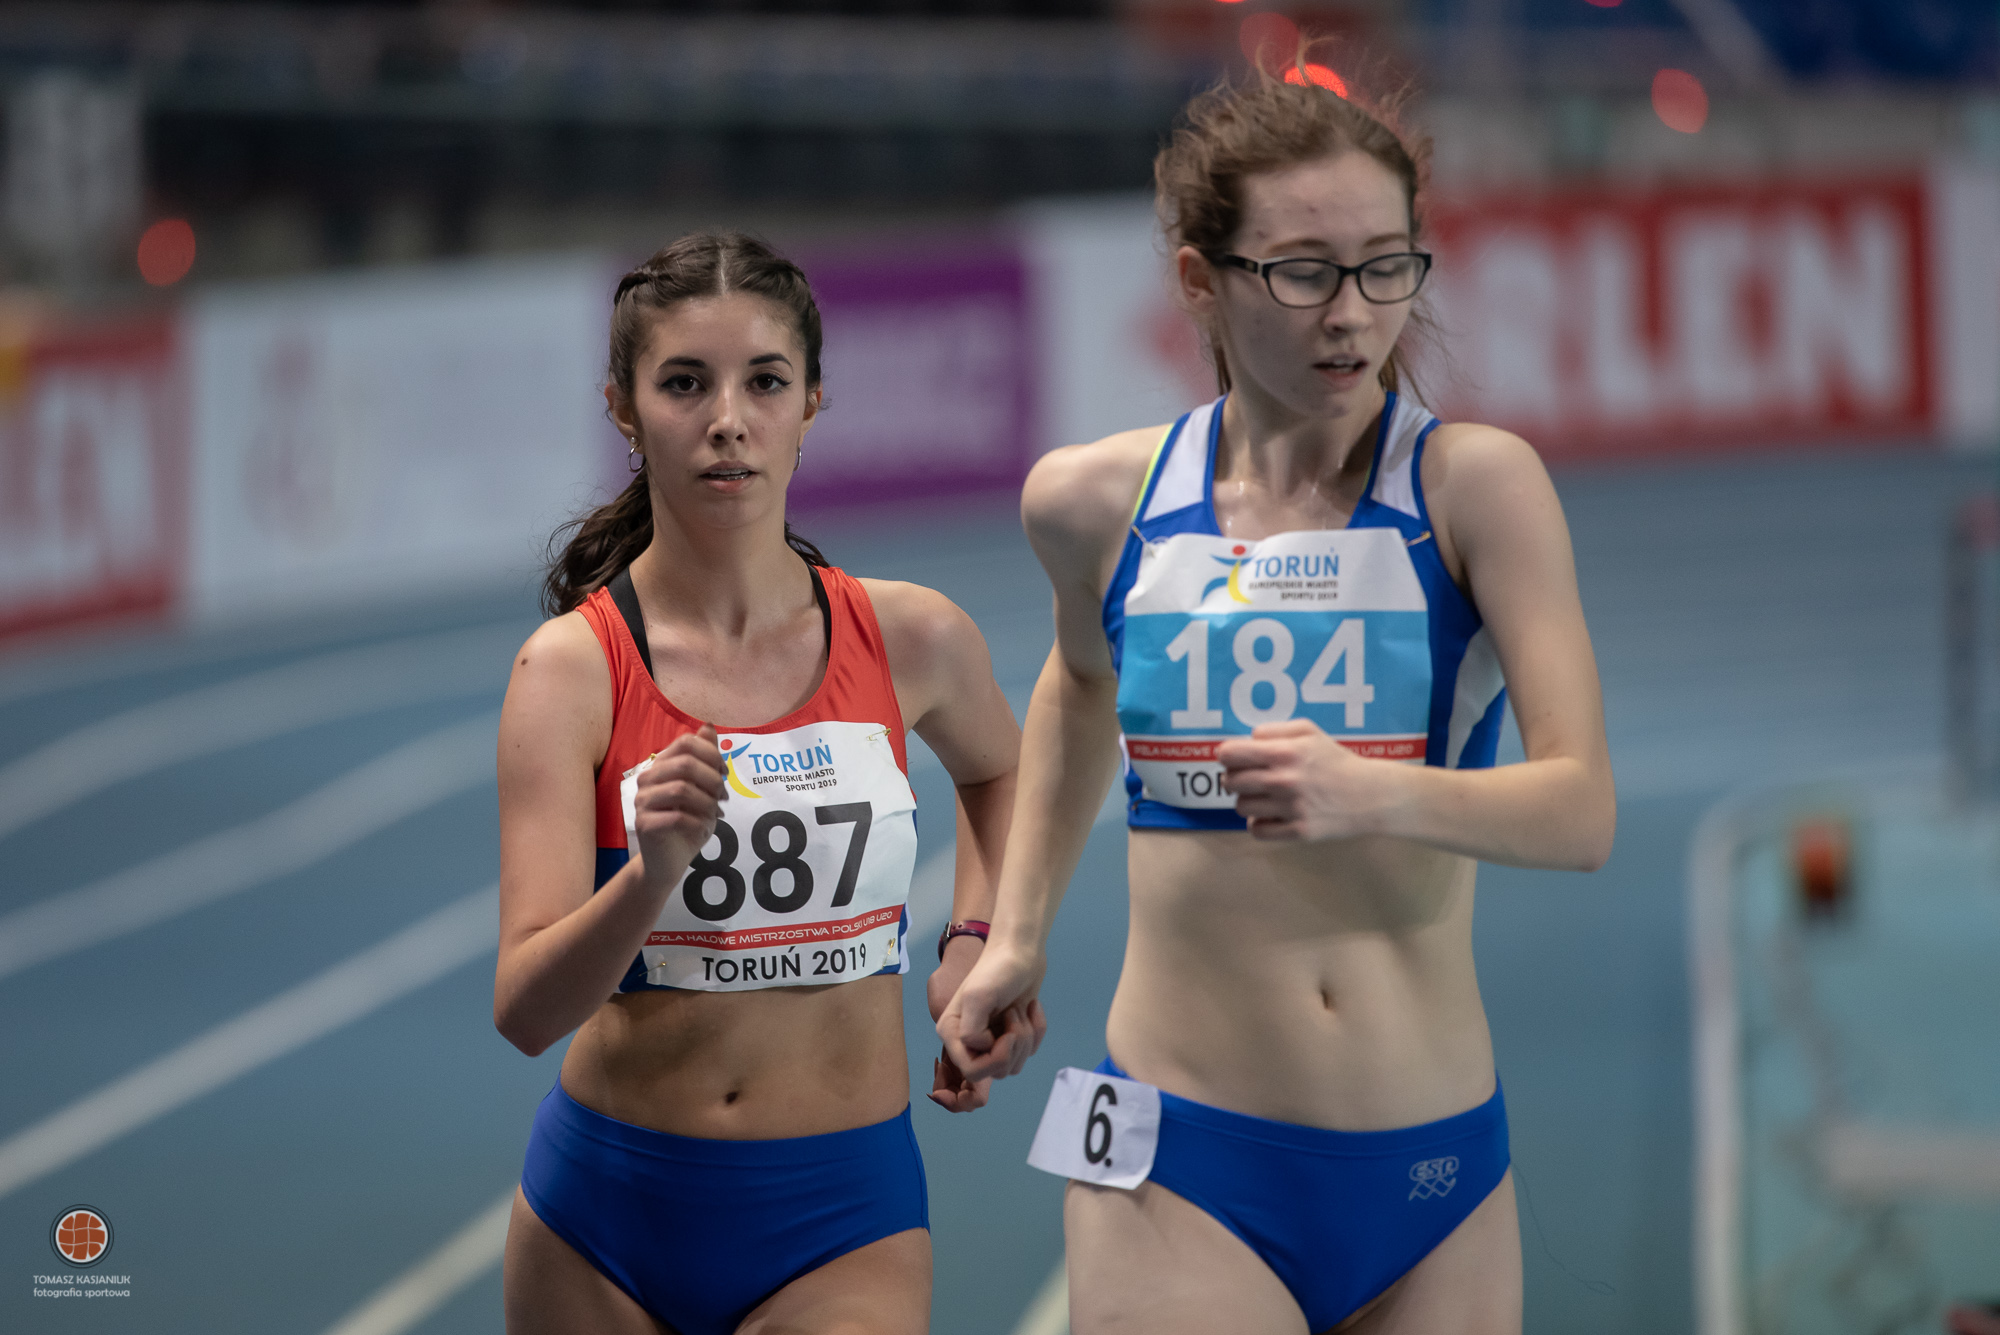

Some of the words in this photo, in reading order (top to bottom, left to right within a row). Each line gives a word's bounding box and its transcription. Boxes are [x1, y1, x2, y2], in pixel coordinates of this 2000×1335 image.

[1430, 205, 1900, 415] RLEN
[1254, 547, 1340, 578] TORUŃ
[1165, 618, 1375, 729] 184
[748, 738, 833, 774] TORUŃ
[752, 774, 804, 786] EUROPEJSKIE
[804, 768, 835, 782] MIASTO
[785, 782, 816, 792] SPORTU
[818, 778, 838, 789] 2019
[1176, 770, 1233, 798] TOR
[682, 801, 873, 920] 887
[651, 934, 684, 943] PZLA
[686, 934, 736, 946] HALOWE
[739, 926, 830, 945] MISTRZOSTWA
[832, 920, 863, 935] POLSKI
[863, 915, 876, 927] U18
[876, 910, 893, 922] U20
[702, 946, 801, 983] TORUŃ
[812, 943, 867, 976] 2019
[1084, 1083, 1118, 1168] 6.
